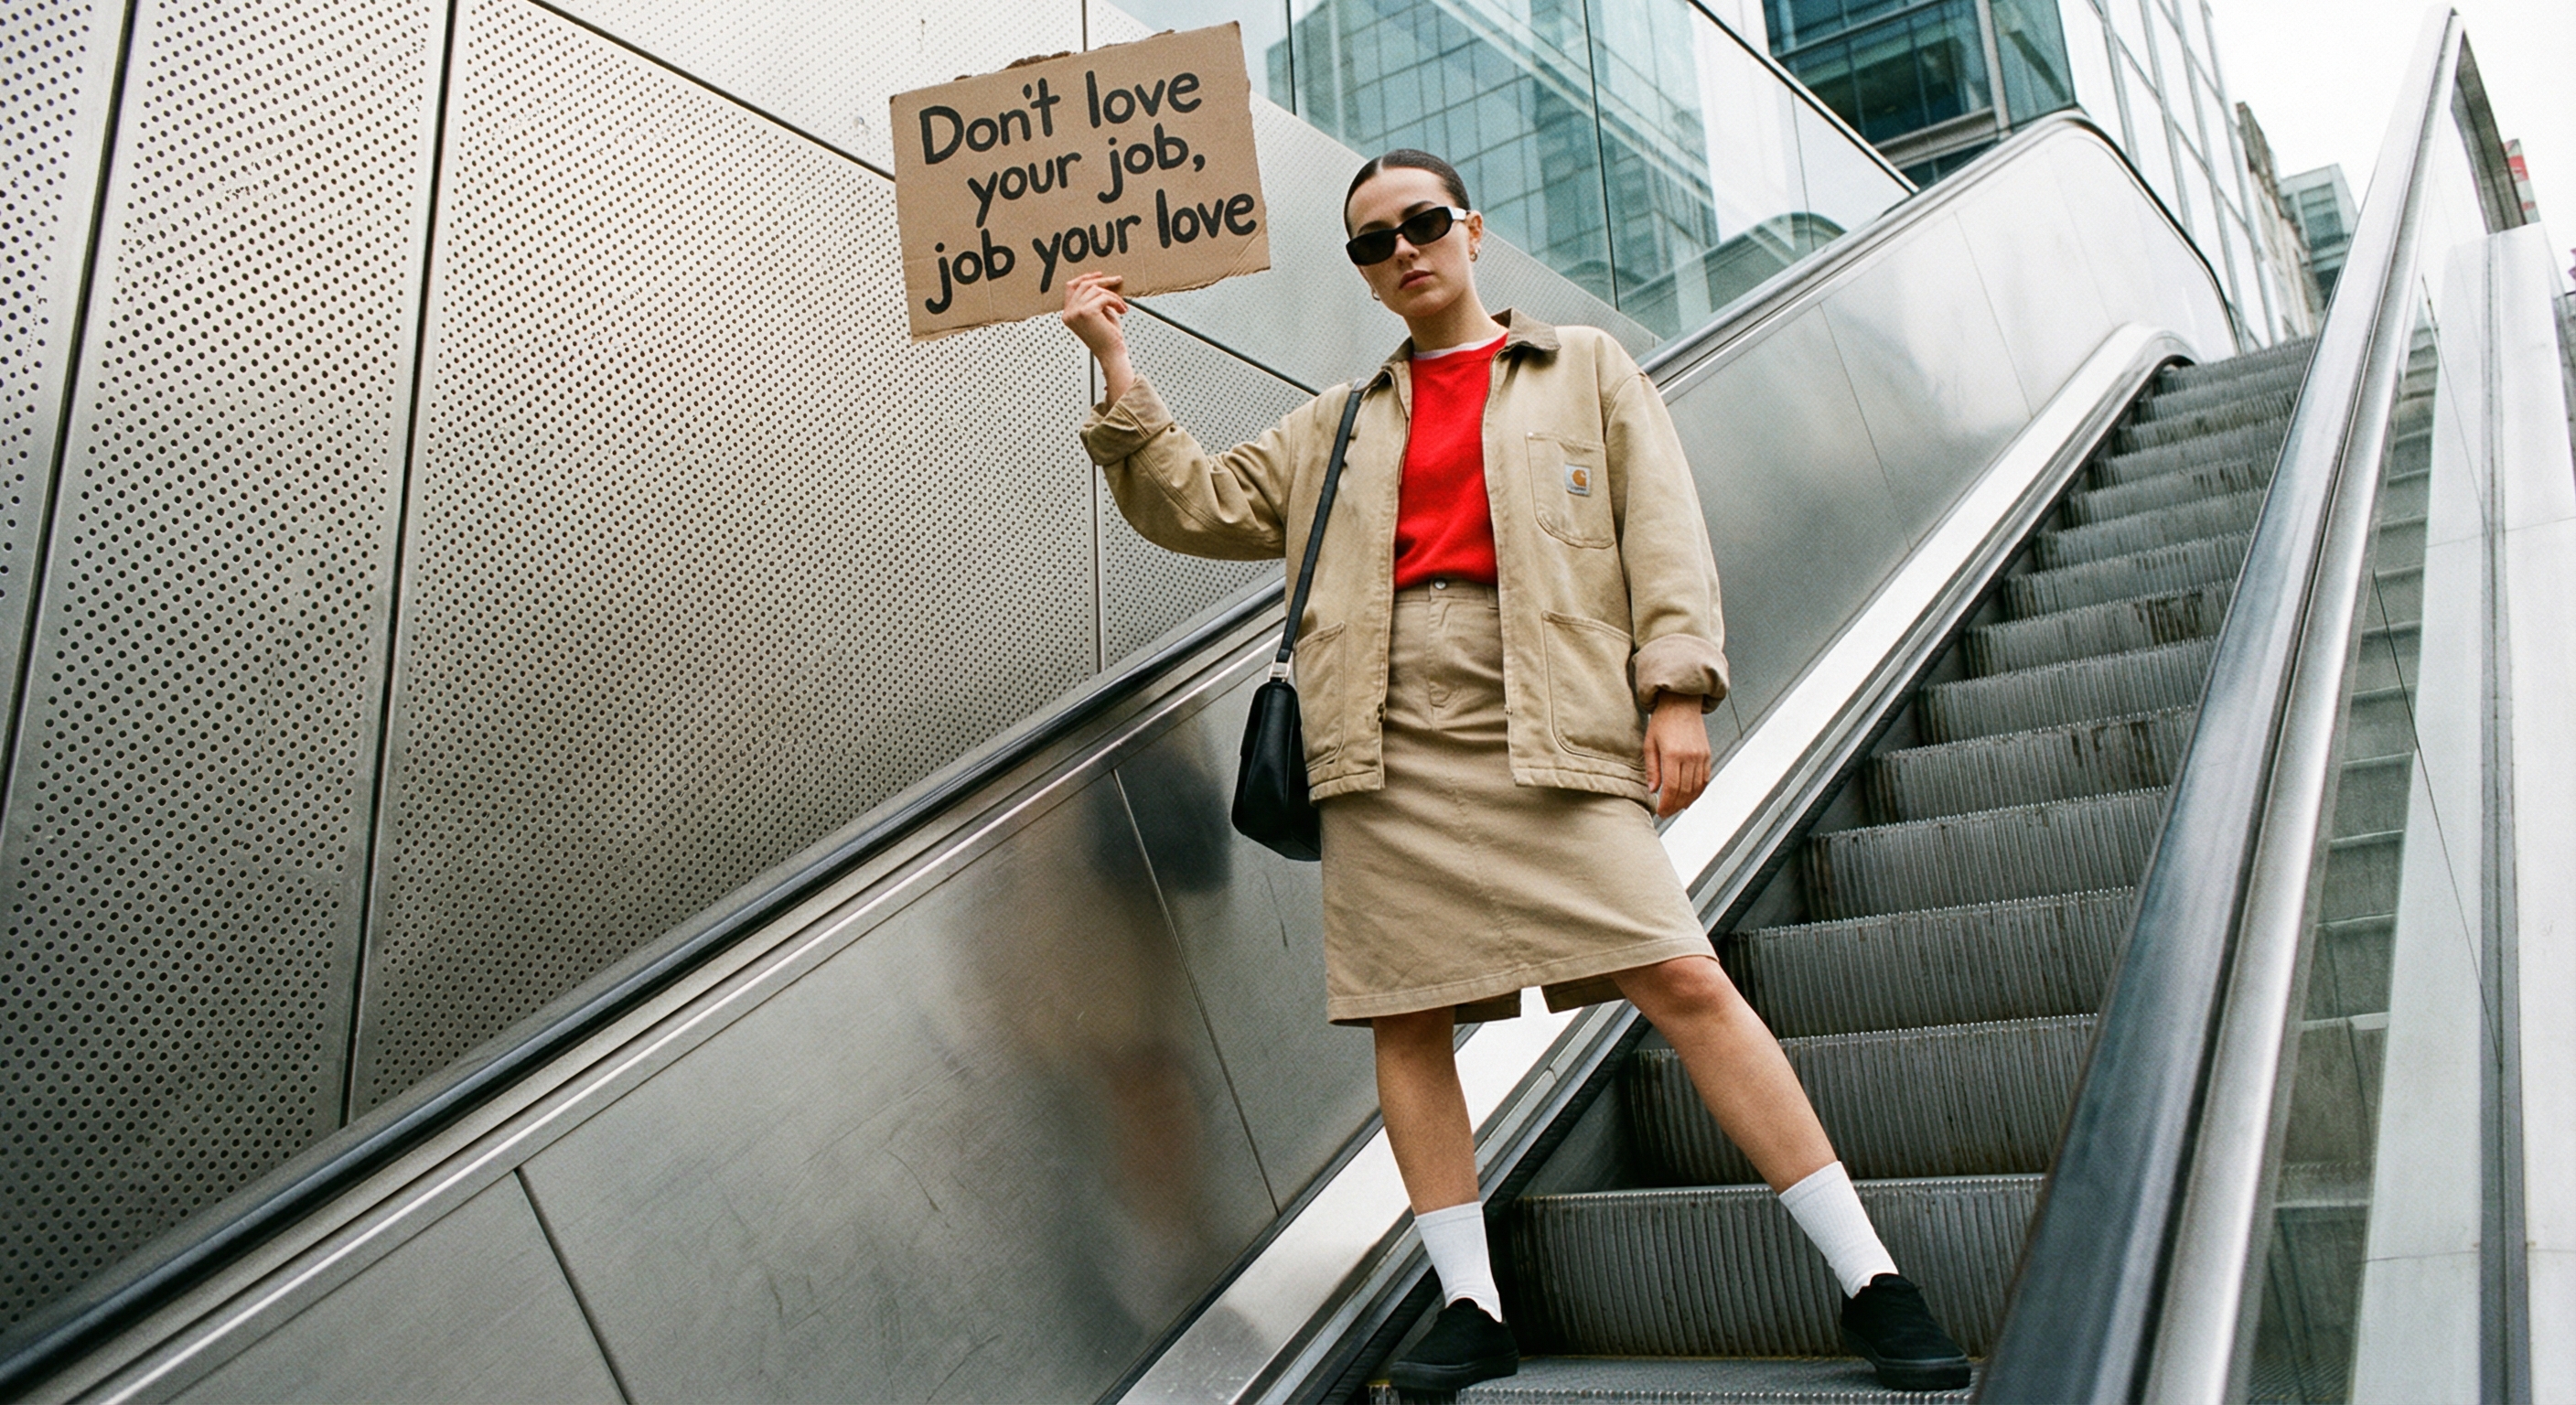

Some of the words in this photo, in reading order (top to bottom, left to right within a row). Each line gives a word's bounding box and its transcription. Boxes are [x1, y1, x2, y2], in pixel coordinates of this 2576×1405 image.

[918, 77, 1061, 166] Don't
[1085, 70, 1203, 129] love
[967, 152, 1082, 229] your
[1097, 123, 1206, 205] job,
[925, 228, 1016, 316] job
[1031, 214, 1143, 295] your
[1155, 188, 1258, 250] love
